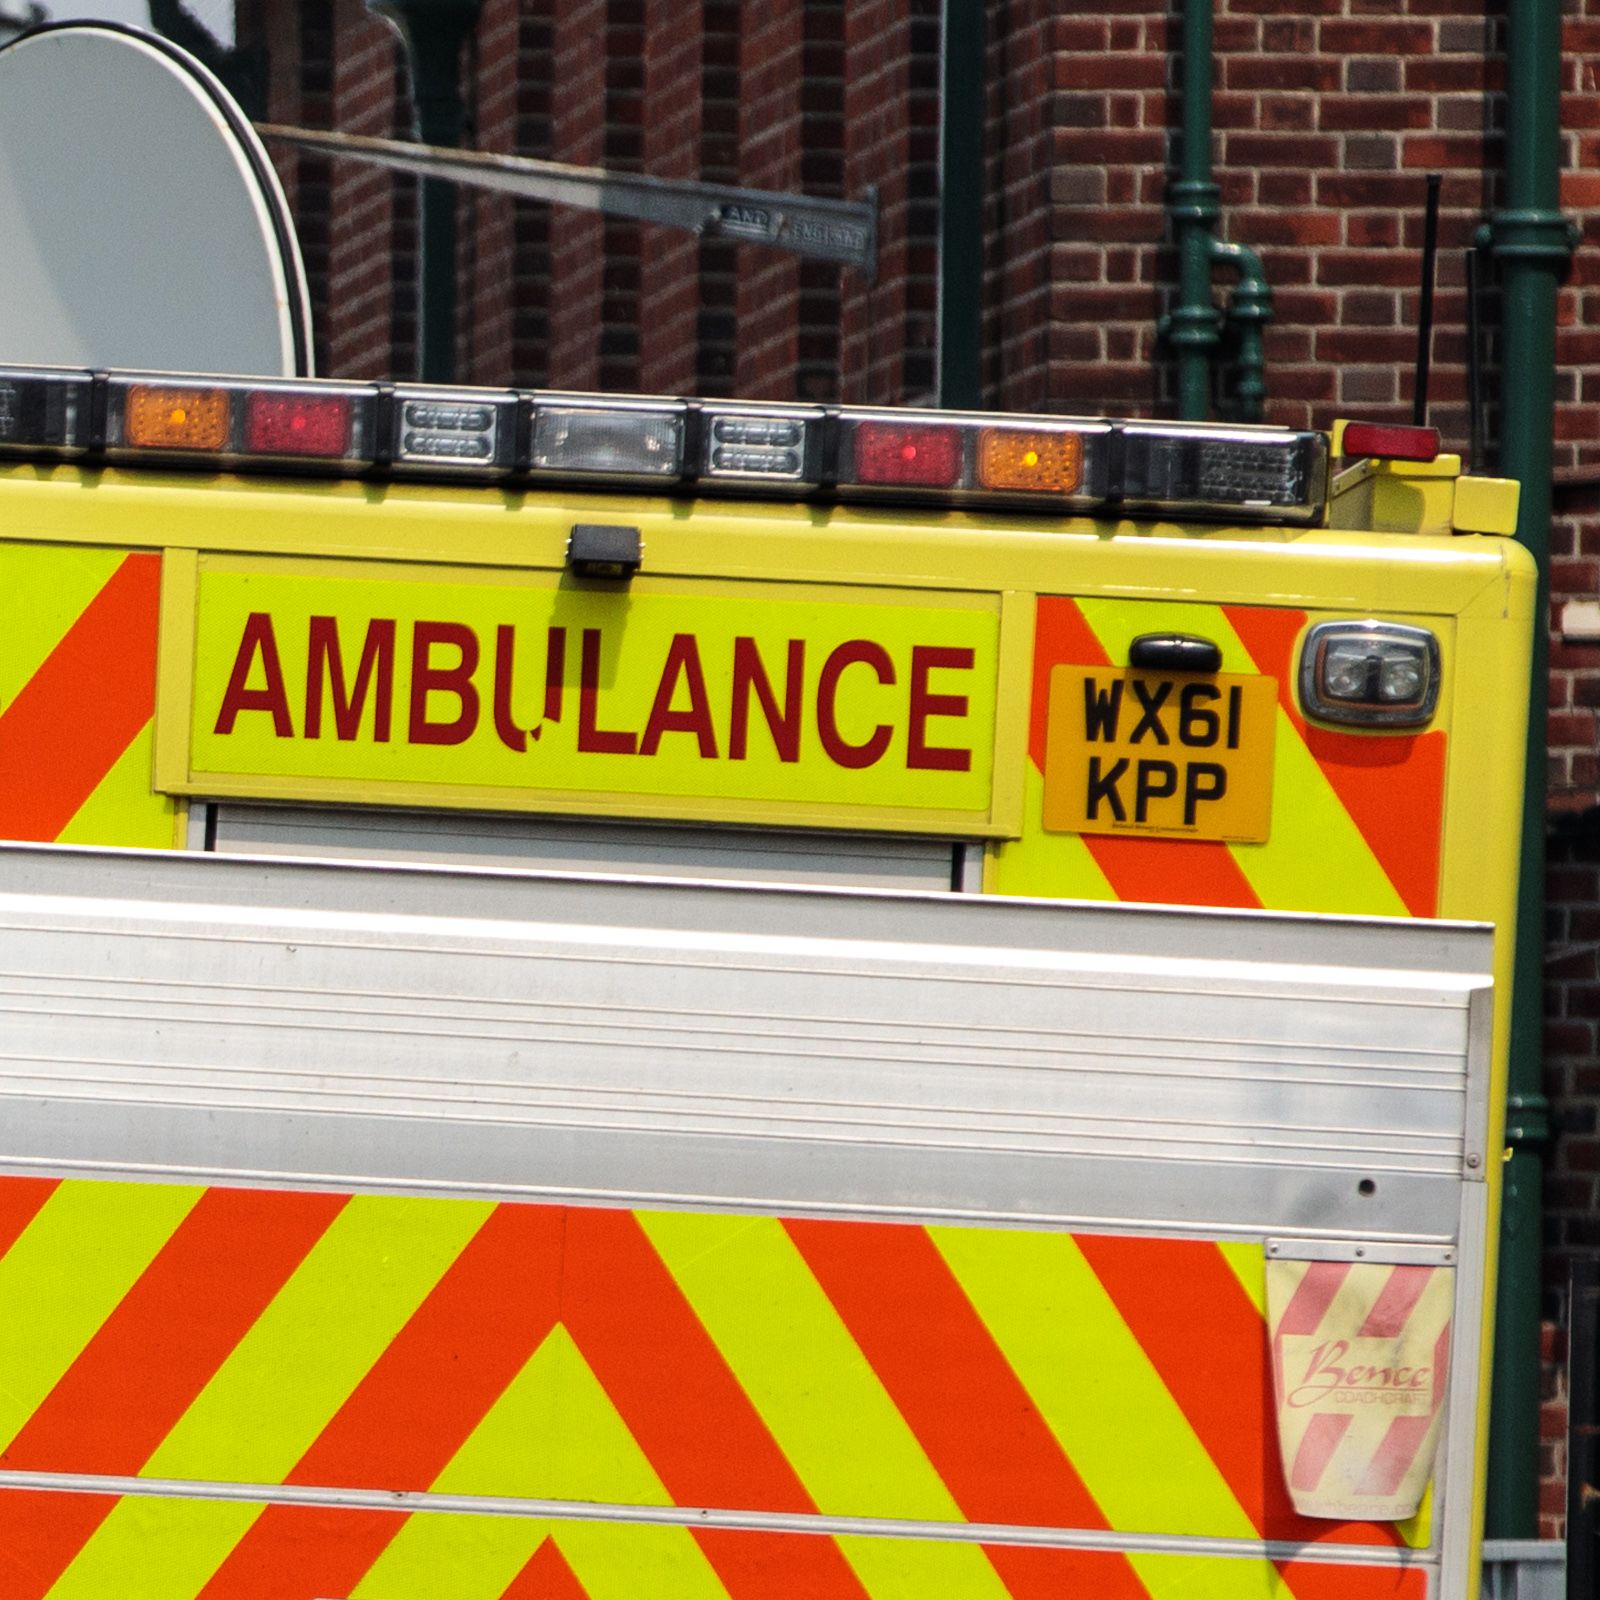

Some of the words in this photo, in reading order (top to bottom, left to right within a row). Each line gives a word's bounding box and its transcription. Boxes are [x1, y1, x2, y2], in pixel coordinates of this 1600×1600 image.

[213, 611, 976, 772] AMBULANCE
[1084, 677, 1243, 749] WX61
[1086, 756, 1228, 826] KPP
[1287, 1340, 1431, 1408] Bence
